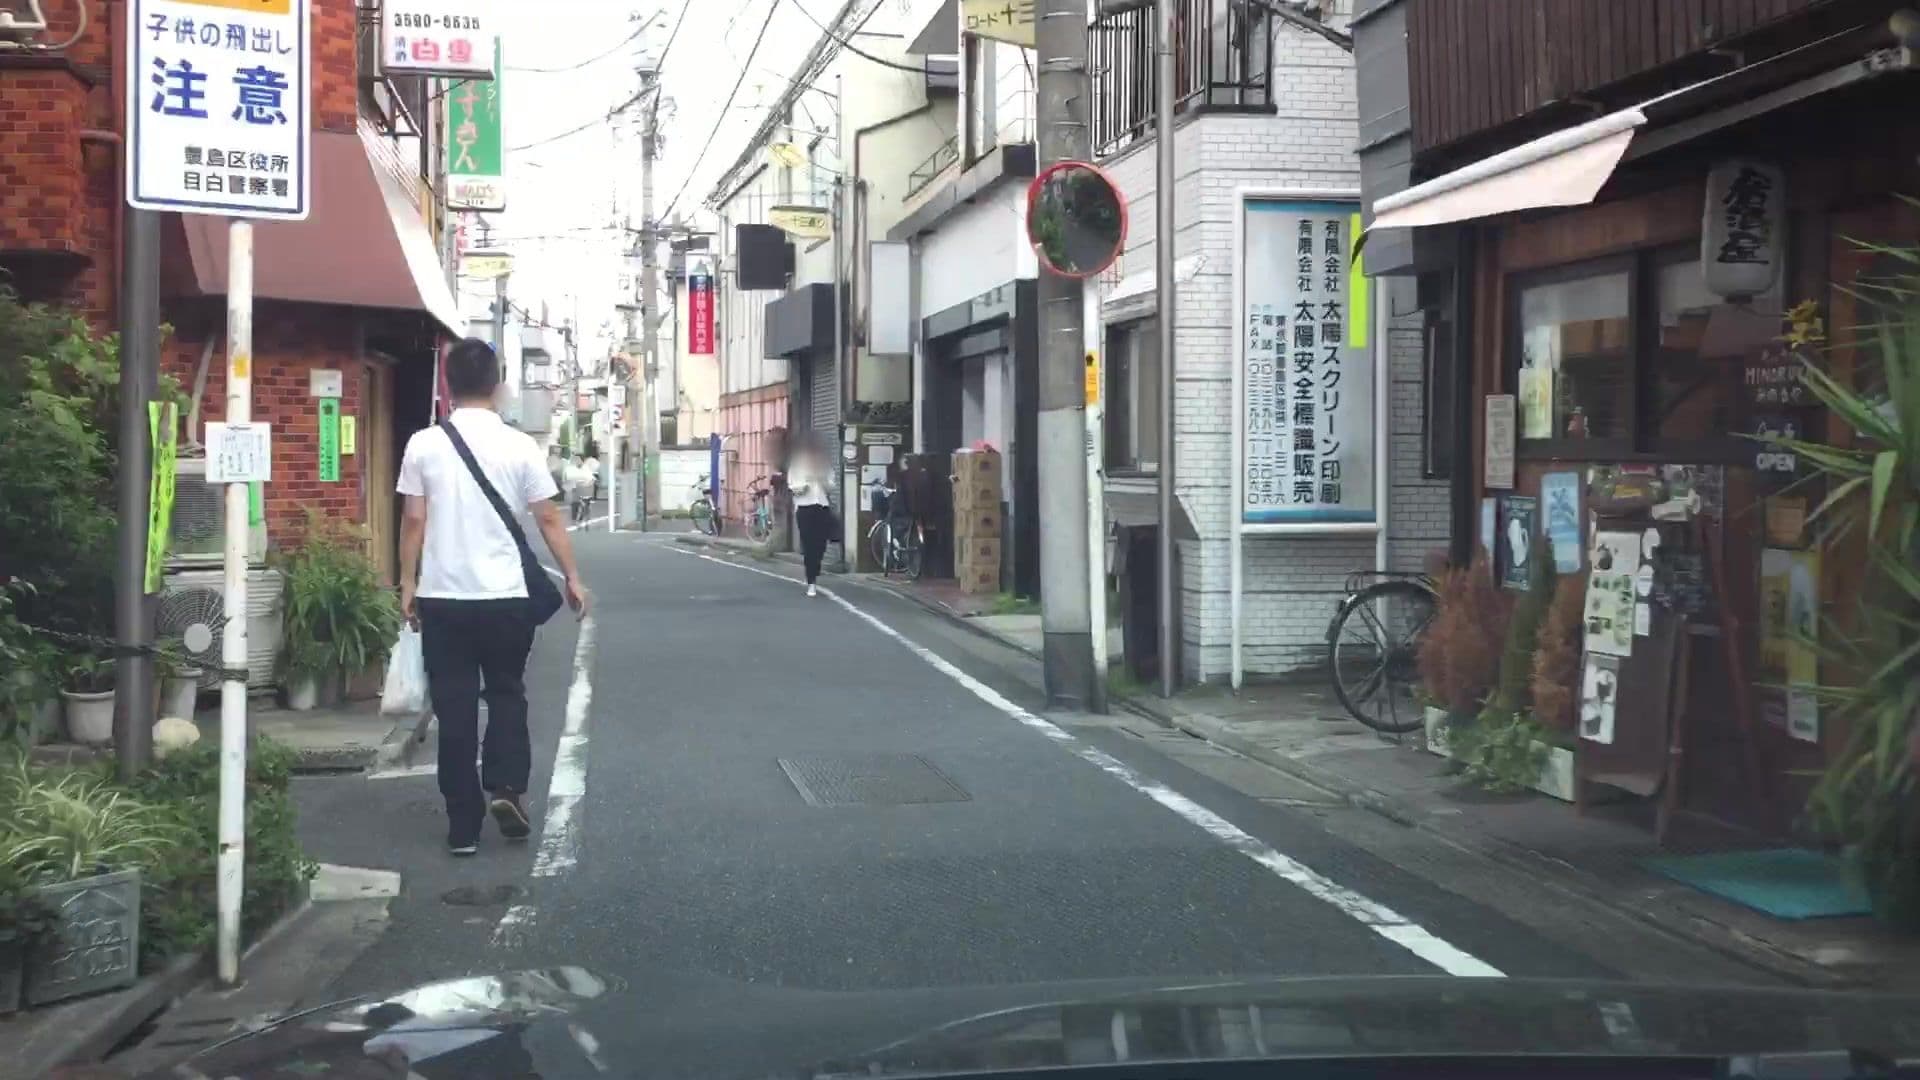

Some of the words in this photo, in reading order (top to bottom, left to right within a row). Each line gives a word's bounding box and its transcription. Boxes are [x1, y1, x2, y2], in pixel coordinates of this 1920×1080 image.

[146, 13, 292, 54] 子供の飛出し
[151, 57, 289, 125] 注意
[184, 146, 289, 173] 豊島区役所
[184, 171, 288, 197] 目白警察署
[1756, 453, 1796, 471] OPEN
